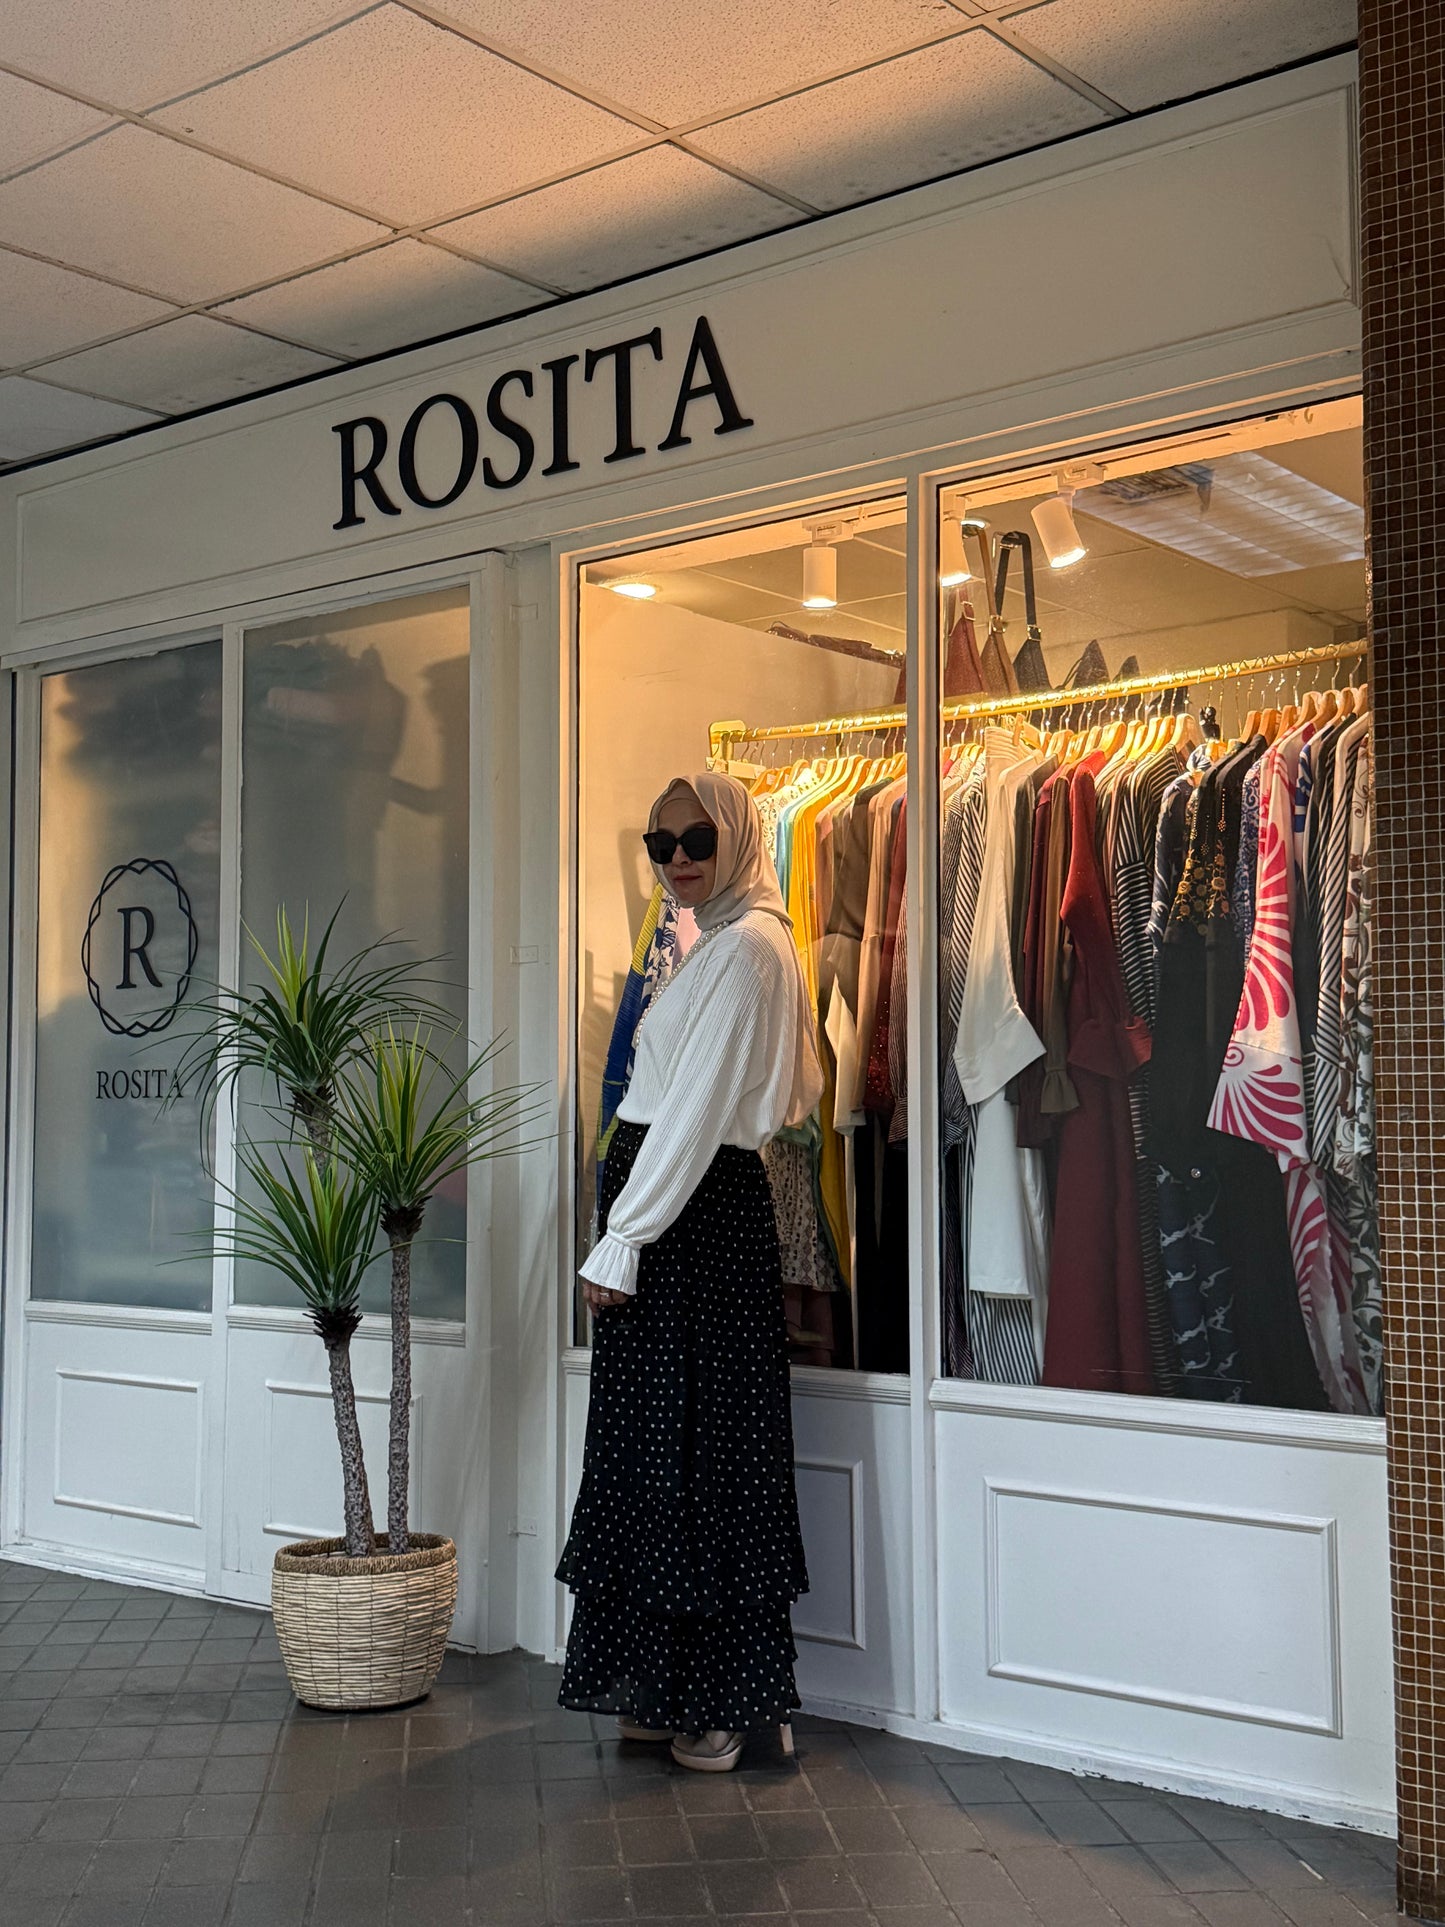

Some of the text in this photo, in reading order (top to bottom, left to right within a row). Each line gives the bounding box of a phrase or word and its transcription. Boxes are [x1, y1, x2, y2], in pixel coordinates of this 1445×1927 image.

[332, 315, 754, 530] ROSITA
[116, 906, 163, 989] R
[96, 1069, 184, 1099] ROSITA
